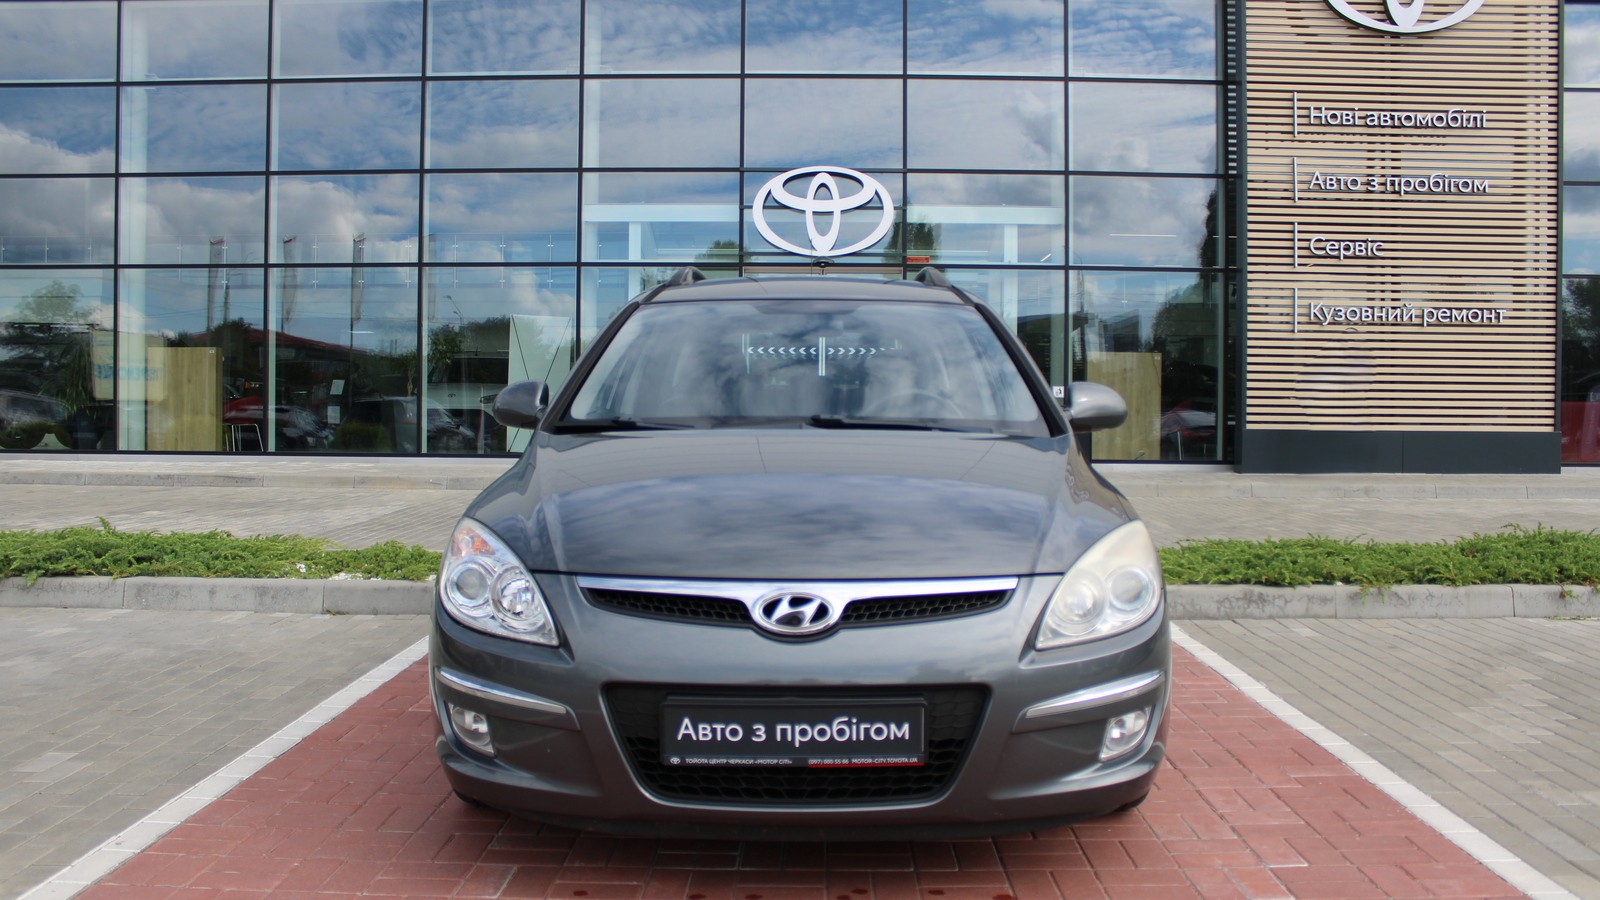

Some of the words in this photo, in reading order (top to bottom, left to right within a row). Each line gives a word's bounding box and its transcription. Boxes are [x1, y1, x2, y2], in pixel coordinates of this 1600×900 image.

[1309, 106, 1359, 125] Нові
[1365, 107, 1488, 128] автомобілі
[1309, 171, 1361, 190] Авто
[1367, 176, 1379, 191] з
[1386, 173, 1489, 196] пробігом
[1309, 237, 1385, 260] Сервіс
[1309, 302, 1416, 326] Кузовний
[1423, 307, 1507, 327] ремонт
[677, 716, 744, 742] Авто
[751, 723, 768, 742] з
[775, 716, 911, 748] пробігом
